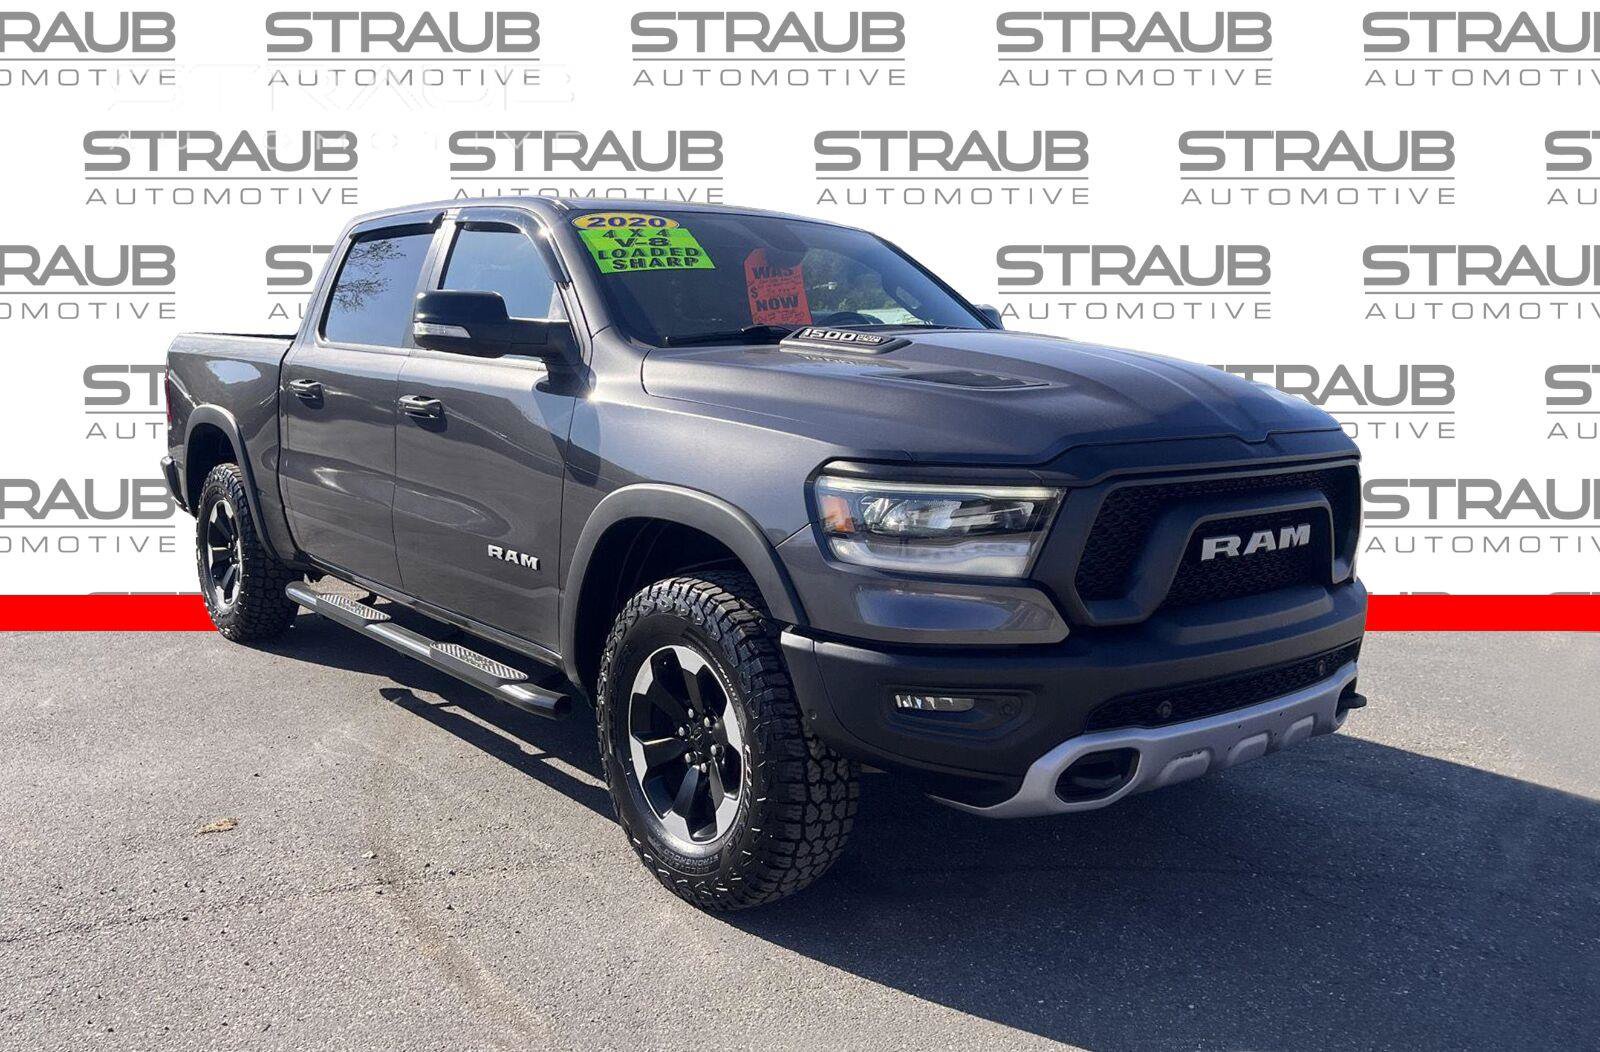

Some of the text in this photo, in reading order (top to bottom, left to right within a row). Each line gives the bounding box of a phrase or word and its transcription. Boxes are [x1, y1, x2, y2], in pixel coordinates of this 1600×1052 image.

[587, 217, 667, 228] 2020
[614, 238, 669, 248] V-8
[597, 247, 700, 260] LOADED
[612, 257, 699, 270] SHARP
[751, 265, 794, 280] WAS
[755, 290, 799, 312] NOW
[800, 328, 858, 342] 1500
[1201, 523, 1310, 561] RAM
[487, 544, 541, 571] RAM
